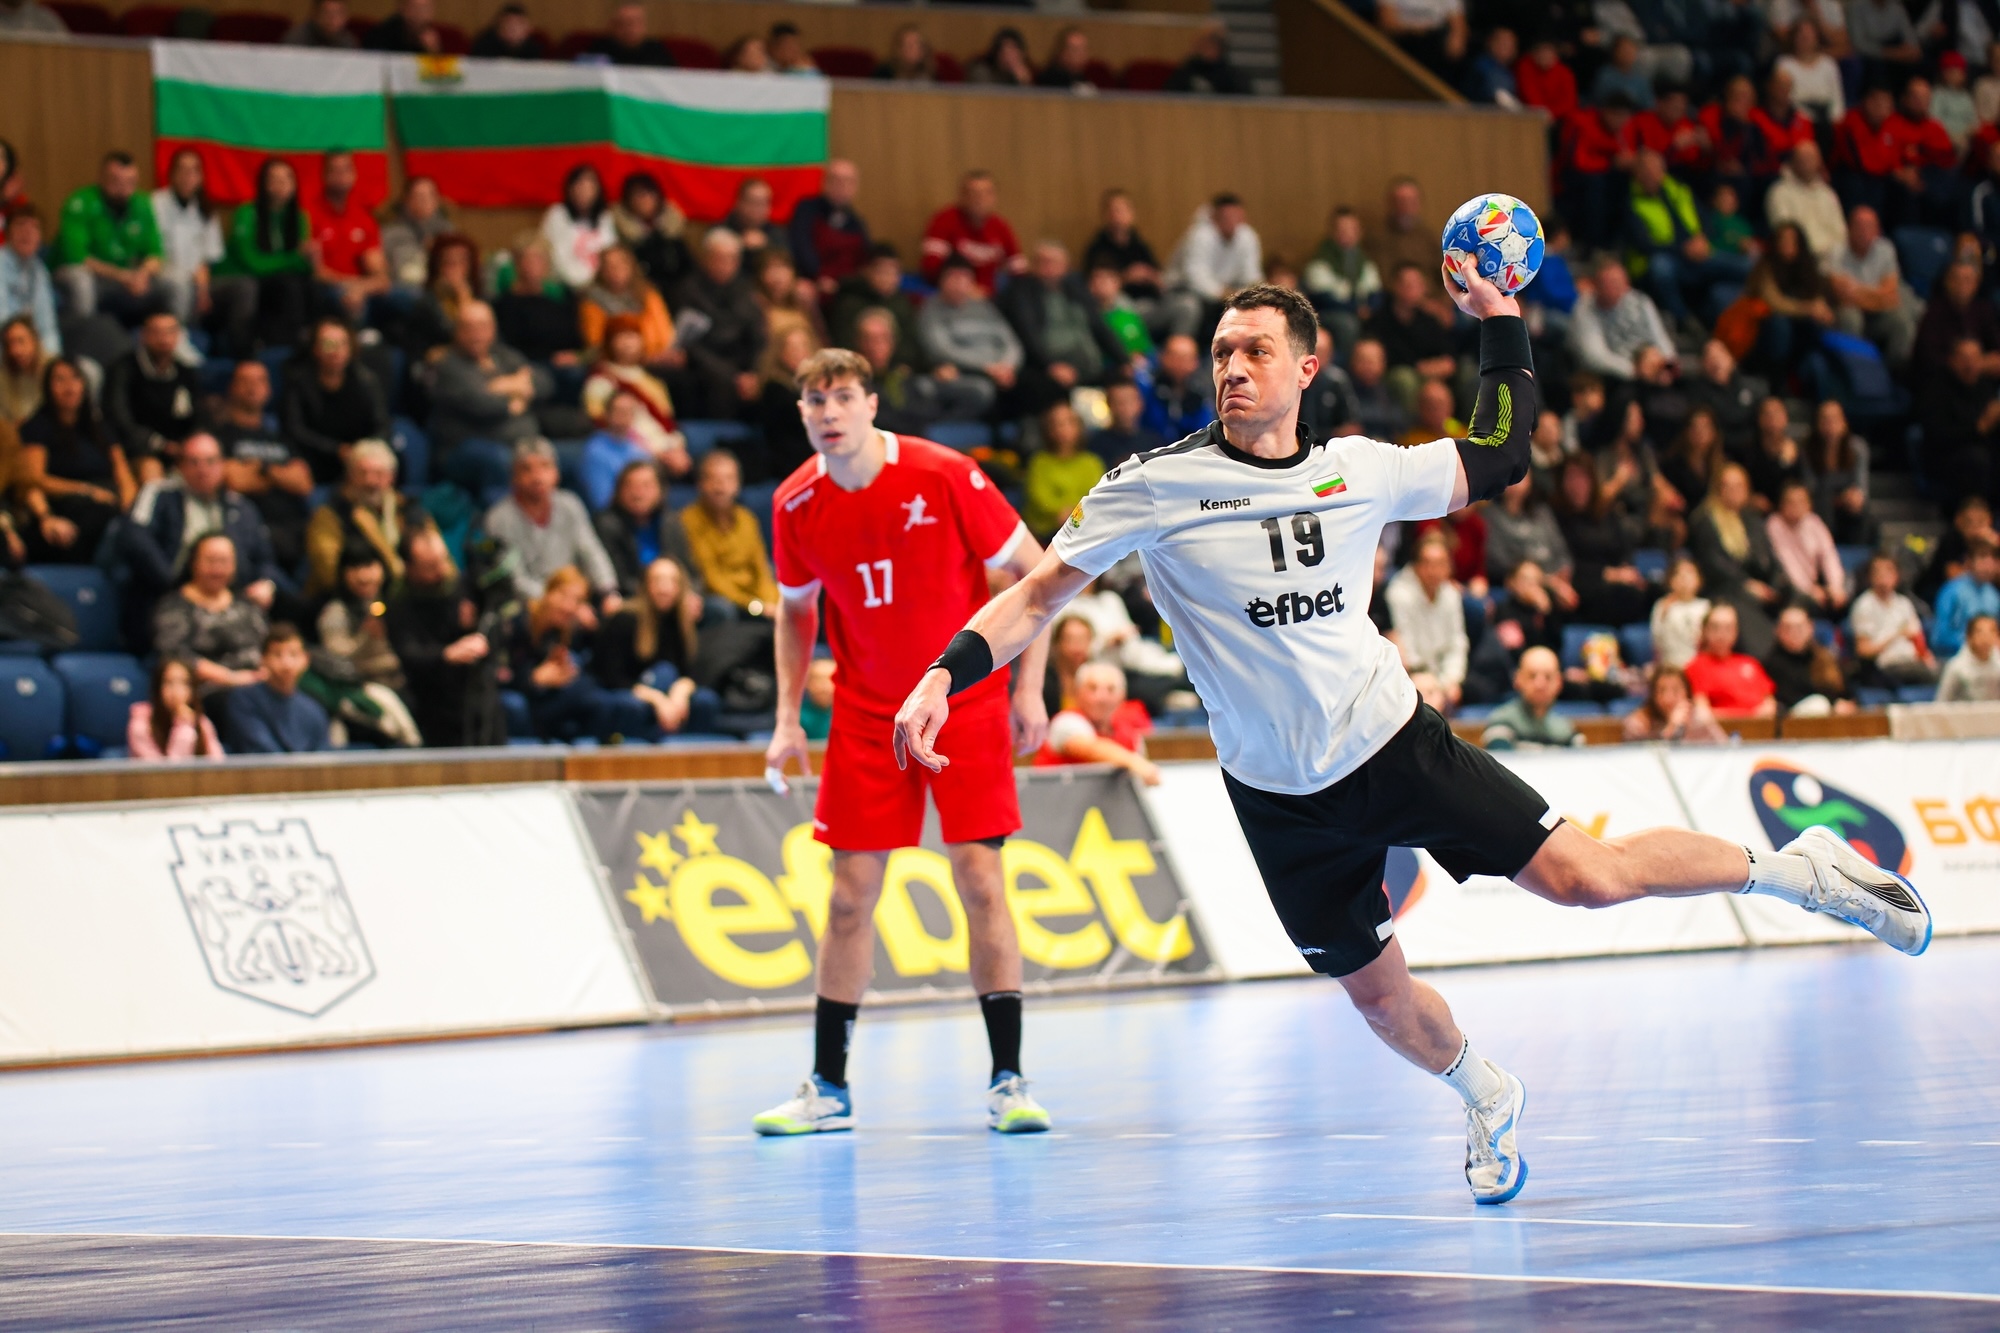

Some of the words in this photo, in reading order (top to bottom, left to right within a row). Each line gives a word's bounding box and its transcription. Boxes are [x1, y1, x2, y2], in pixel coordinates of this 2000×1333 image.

[1199, 497, 1251, 511] Kempa
[1260, 510, 1325, 573] 19
[855, 558, 893, 609] 17
[1247, 582, 1345, 628] efbet
